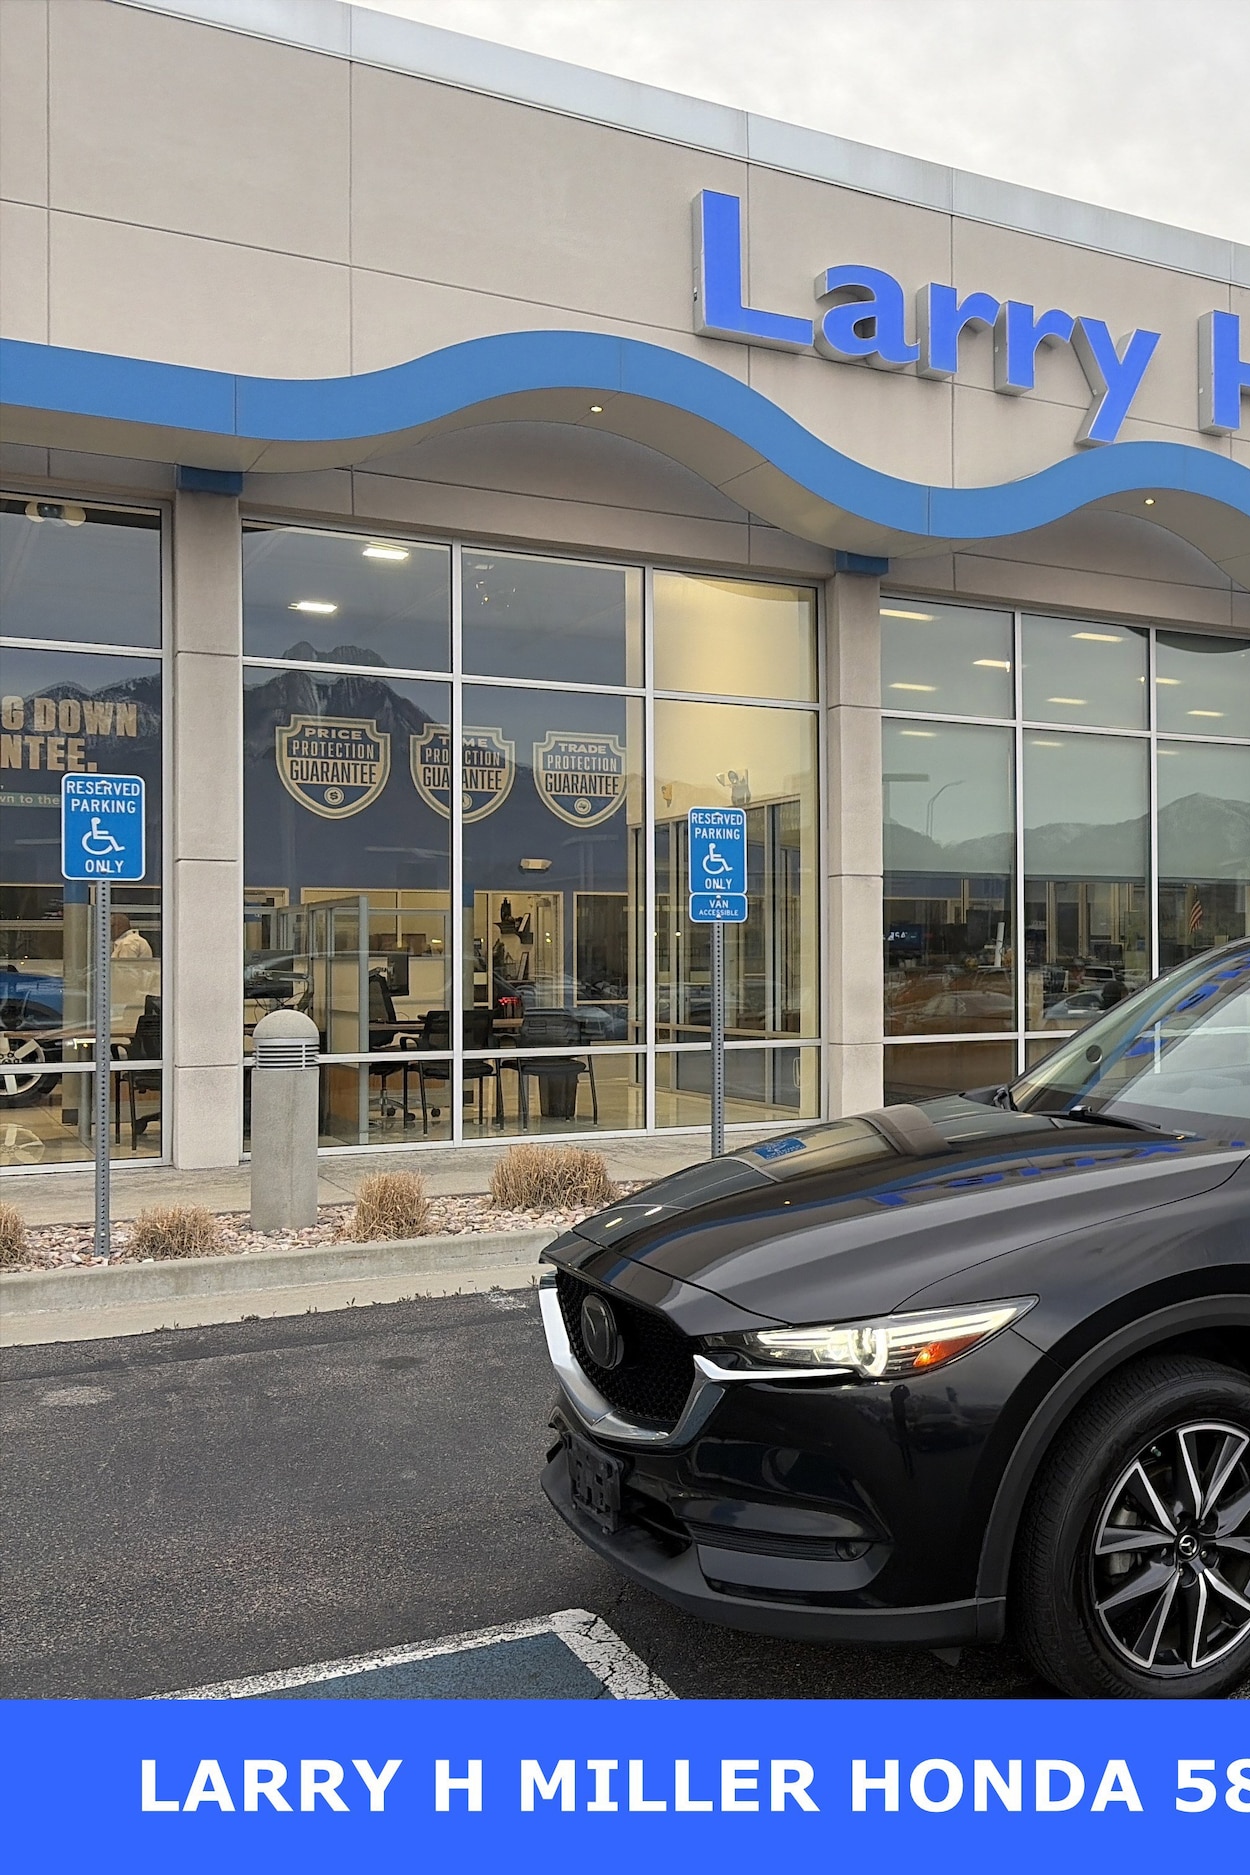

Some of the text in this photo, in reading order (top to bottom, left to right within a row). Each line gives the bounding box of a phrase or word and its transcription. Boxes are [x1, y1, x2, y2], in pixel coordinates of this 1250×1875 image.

[696, 190, 1158, 446] Larry
[1, 696, 137, 737] G DOWN
[304, 727, 363, 741] PRICE
[438, 735, 488, 748] TME
[0, 734, 98, 773] NTEE.
[292, 740, 375, 760] PROTECTION
[558, 743, 607, 754] TRADE
[425, 747, 501, 767] PROCTION
[547, 755, 618, 772] PROTECTION
[290, 759, 377, 785] GUARANTEE
[422, 766, 503, 791] GUAANTEE
[66, 780, 141, 797] RESERVED
[545, 772, 620, 796] GUARANTEE
[19, 794, 34, 805] to
[38, 795, 61, 806] the
[71, 799, 136, 814] PARKING
[691, 812, 743, 826] RESERVED
[694, 827, 741, 840] PARKING
[85, 859, 124, 874] ONLY
[704, 877, 733, 890] ONLY
[708, 899, 729, 909] VAN
[698, 909, 739, 917] ACCESSIBLE
